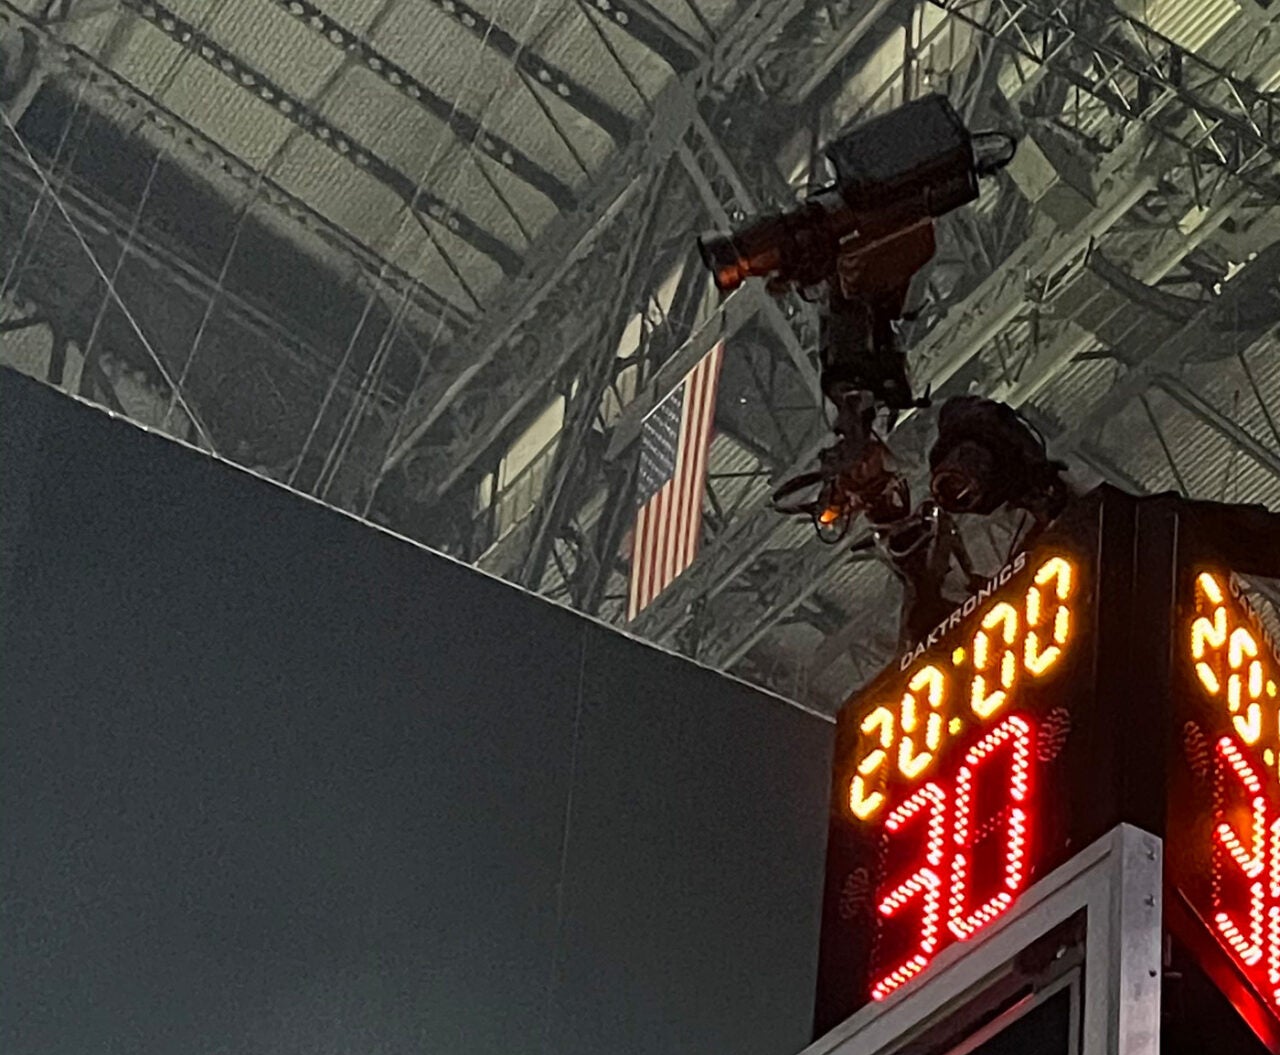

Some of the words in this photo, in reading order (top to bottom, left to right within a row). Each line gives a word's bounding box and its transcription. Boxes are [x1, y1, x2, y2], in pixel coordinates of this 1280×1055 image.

[849, 557, 1072, 819] 20:00
[901, 552, 1026, 671] DAKTRONICS
[872, 716, 1030, 1001] 30
